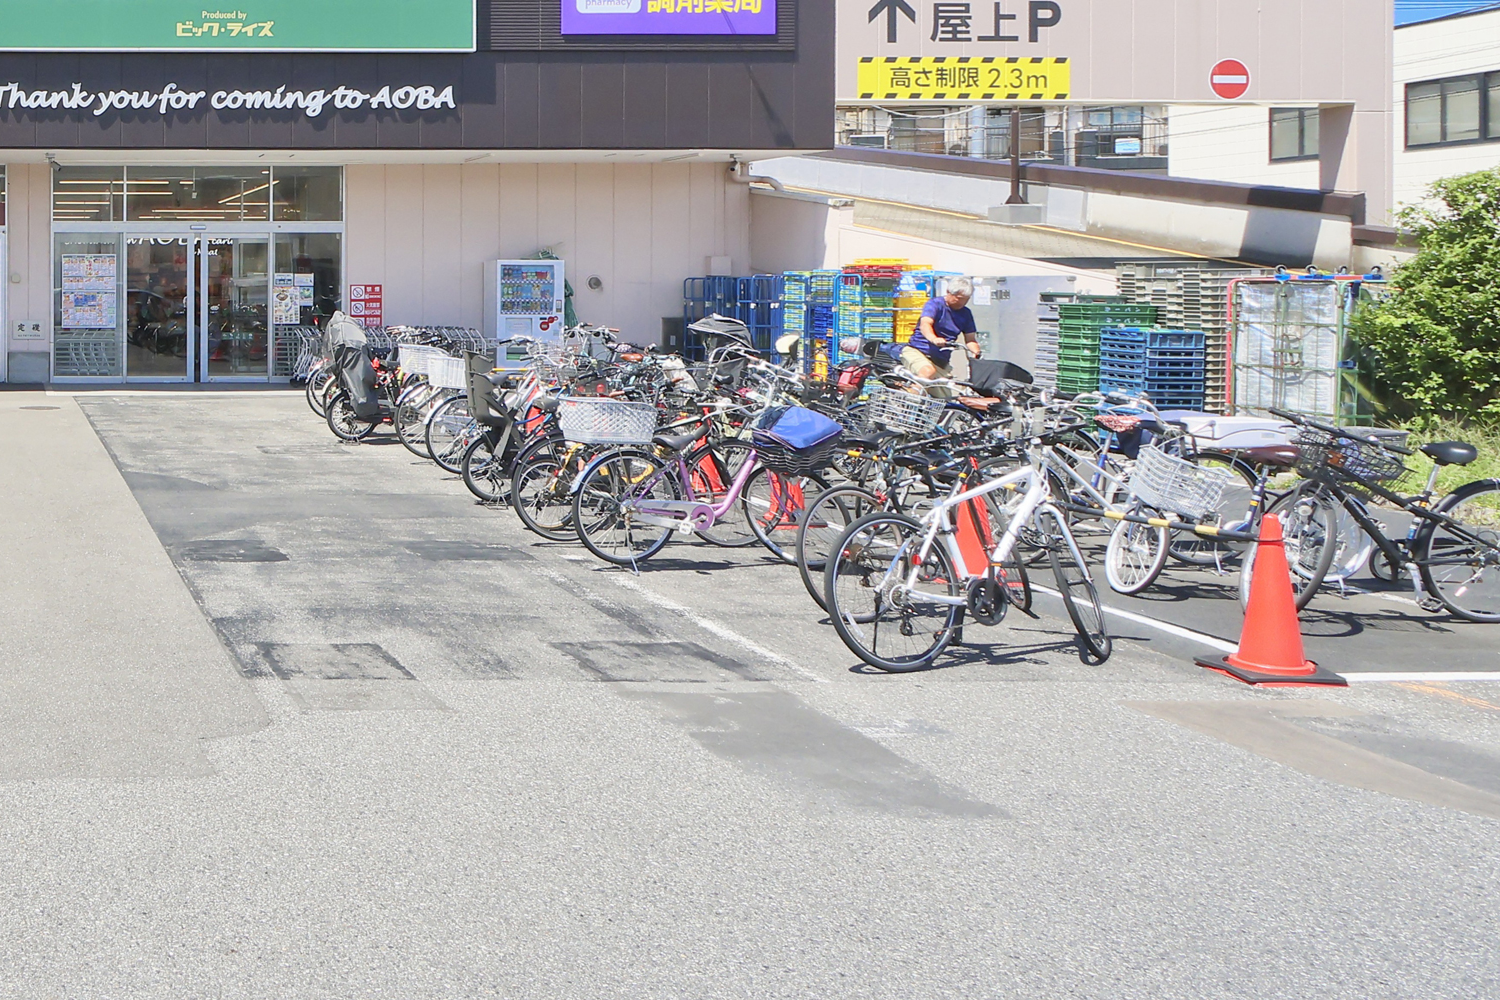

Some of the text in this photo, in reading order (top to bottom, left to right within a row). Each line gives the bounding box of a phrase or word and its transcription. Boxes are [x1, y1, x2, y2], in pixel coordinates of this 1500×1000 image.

[202, 10, 247, 21] Produced by
[889, 67, 1048, 88] 高さ制限 2.3m
[93, 88, 161, 116] you
[157, 82, 207, 115] for
[211, 84, 333, 118] coming
[329, 85, 371, 110] to
[370, 85, 457, 110] AOBA
